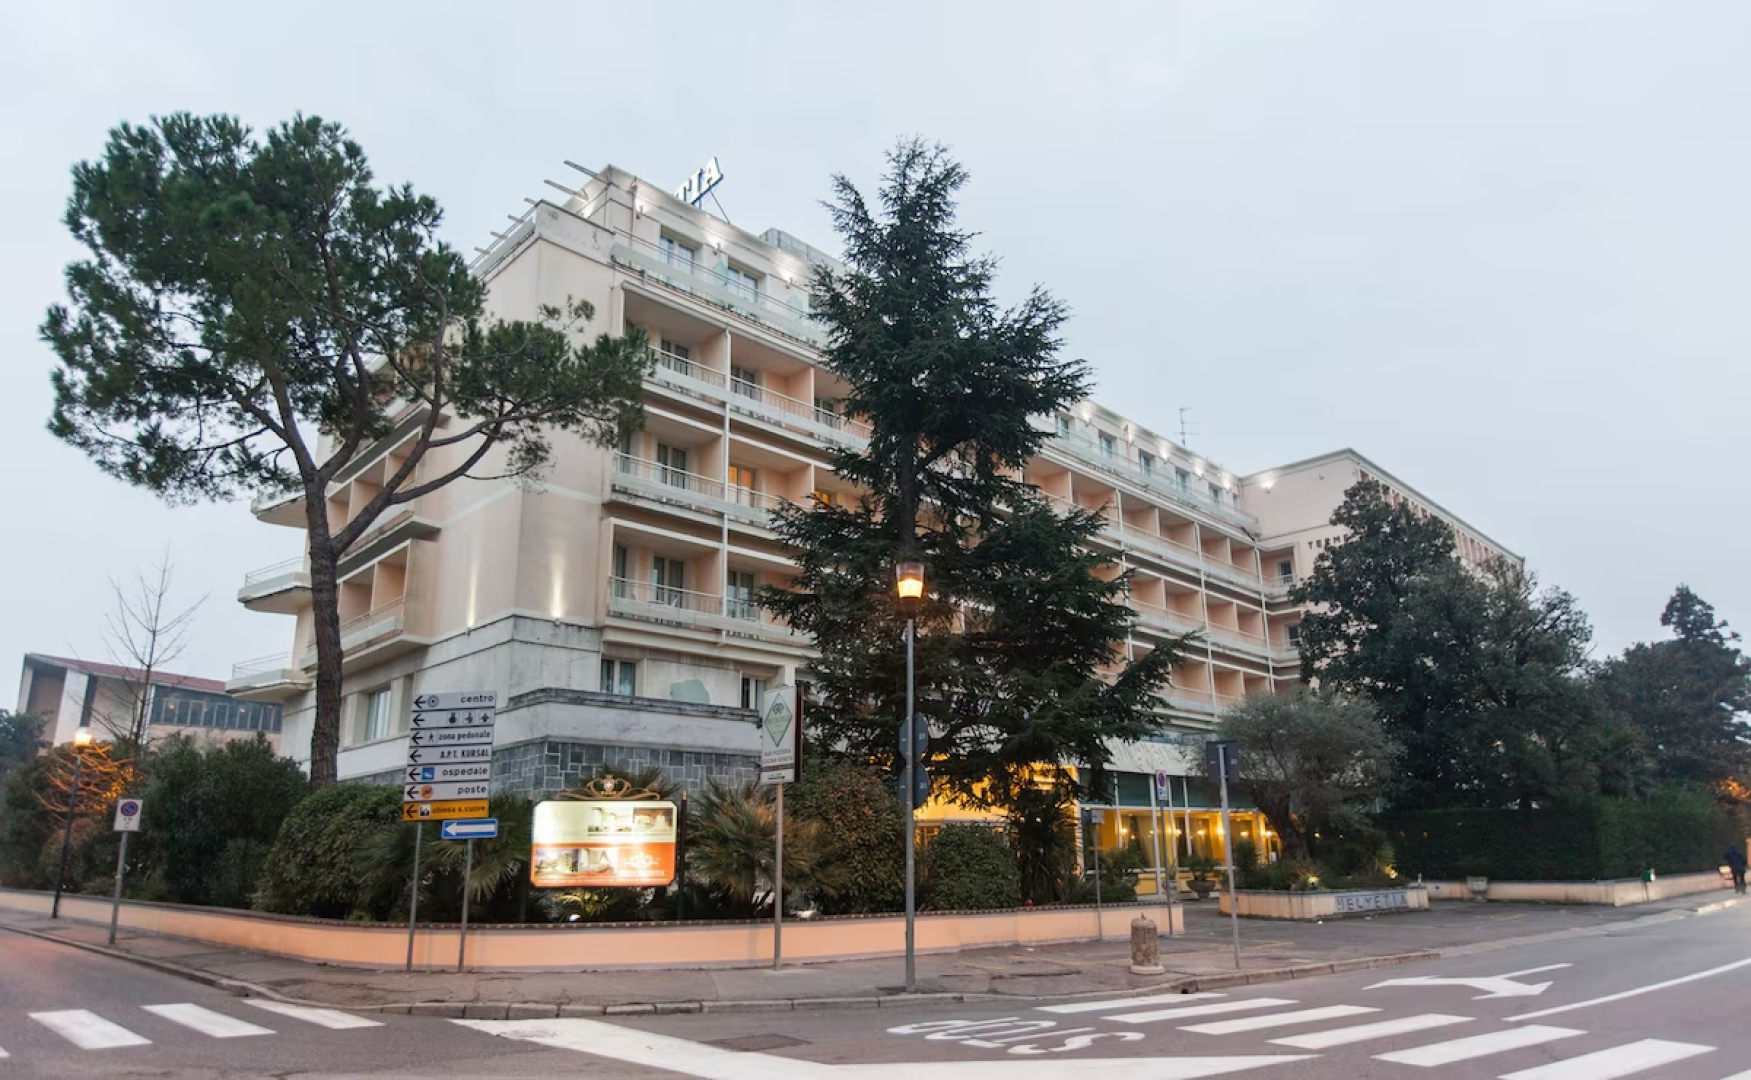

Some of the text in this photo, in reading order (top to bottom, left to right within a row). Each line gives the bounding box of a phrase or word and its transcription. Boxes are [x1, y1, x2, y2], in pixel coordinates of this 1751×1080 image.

[461, 694, 494, 703] centro
[439, 730, 490, 741] zona pedonale
[461, 748, 490, 758] KURSAL
[442, 767, 488, 777] ospedale
[457, 785, 487, 795] poste
